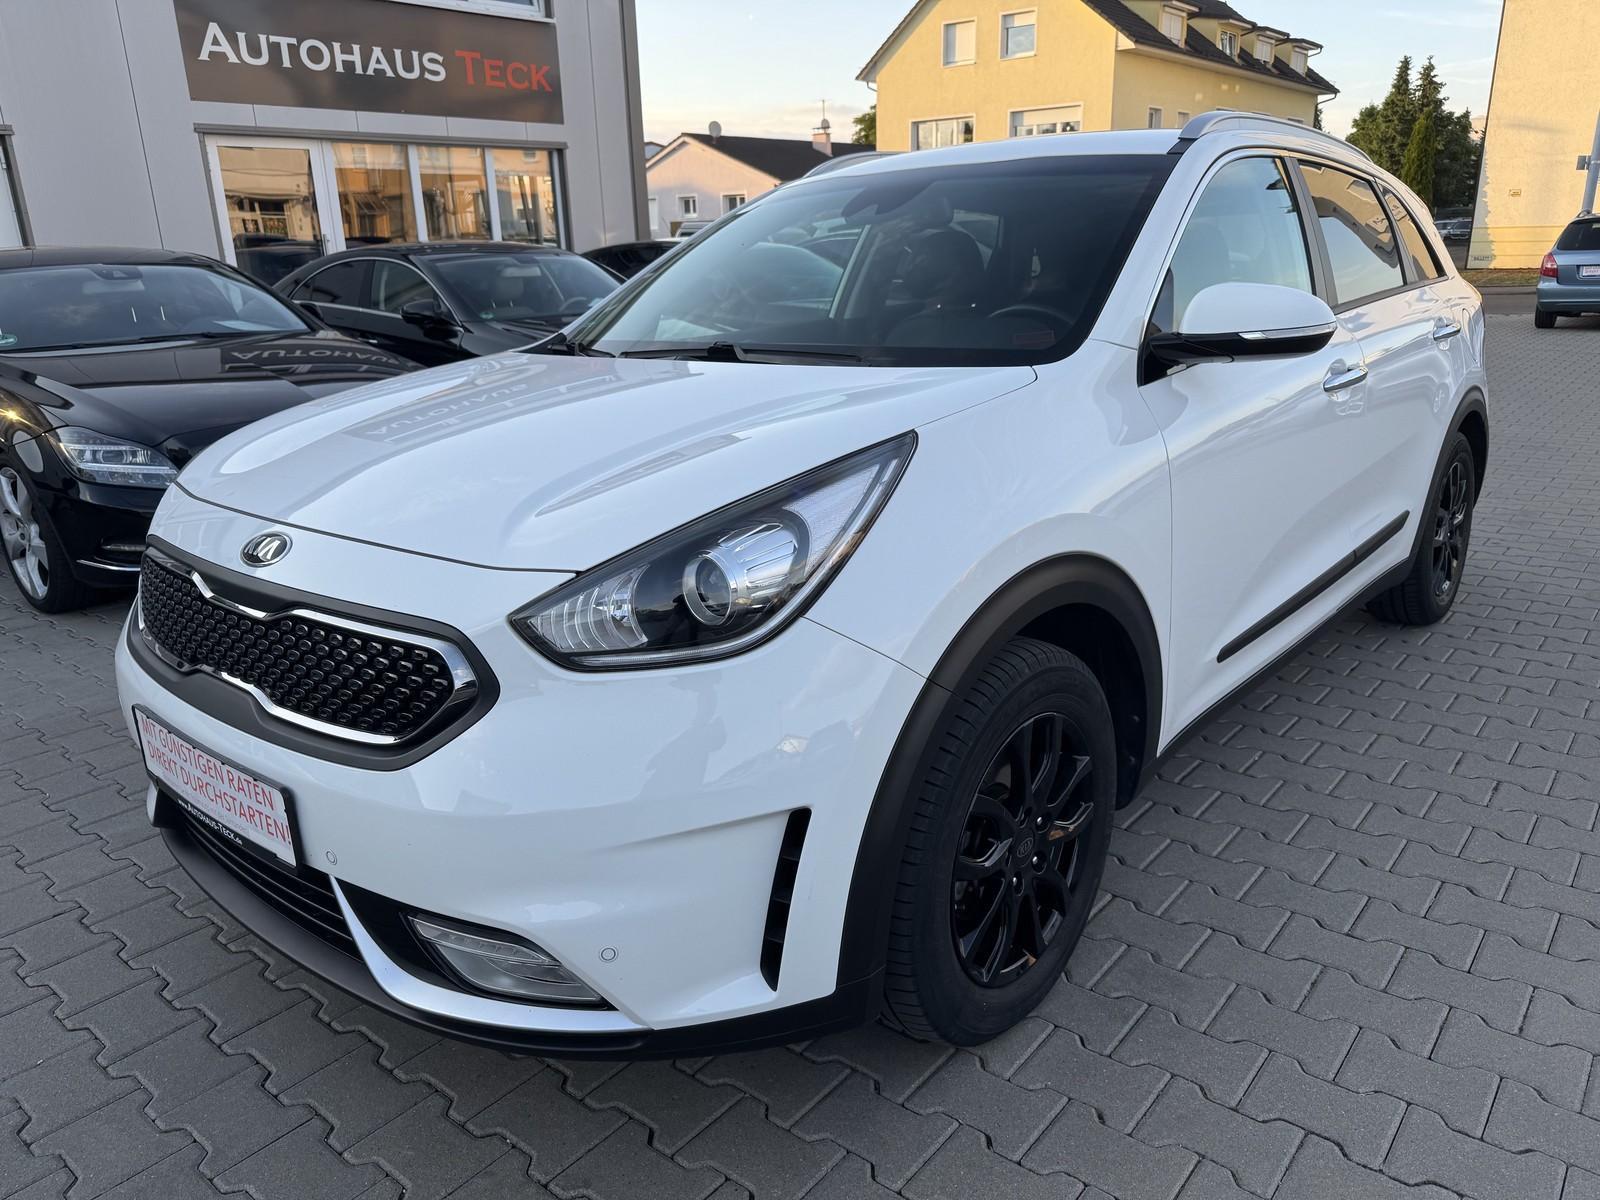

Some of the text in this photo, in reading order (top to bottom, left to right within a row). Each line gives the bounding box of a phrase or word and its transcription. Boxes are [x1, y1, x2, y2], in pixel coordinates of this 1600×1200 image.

[197, 22, 553, 92] AUTOHAUS TECK
[141, 716, 157, 740] MIT
[226, 769, 274, 811] RATEN
[147, 740, 179, 779] DIREKT
[180, 766, 292, 846] DURCHSTARTEN!
